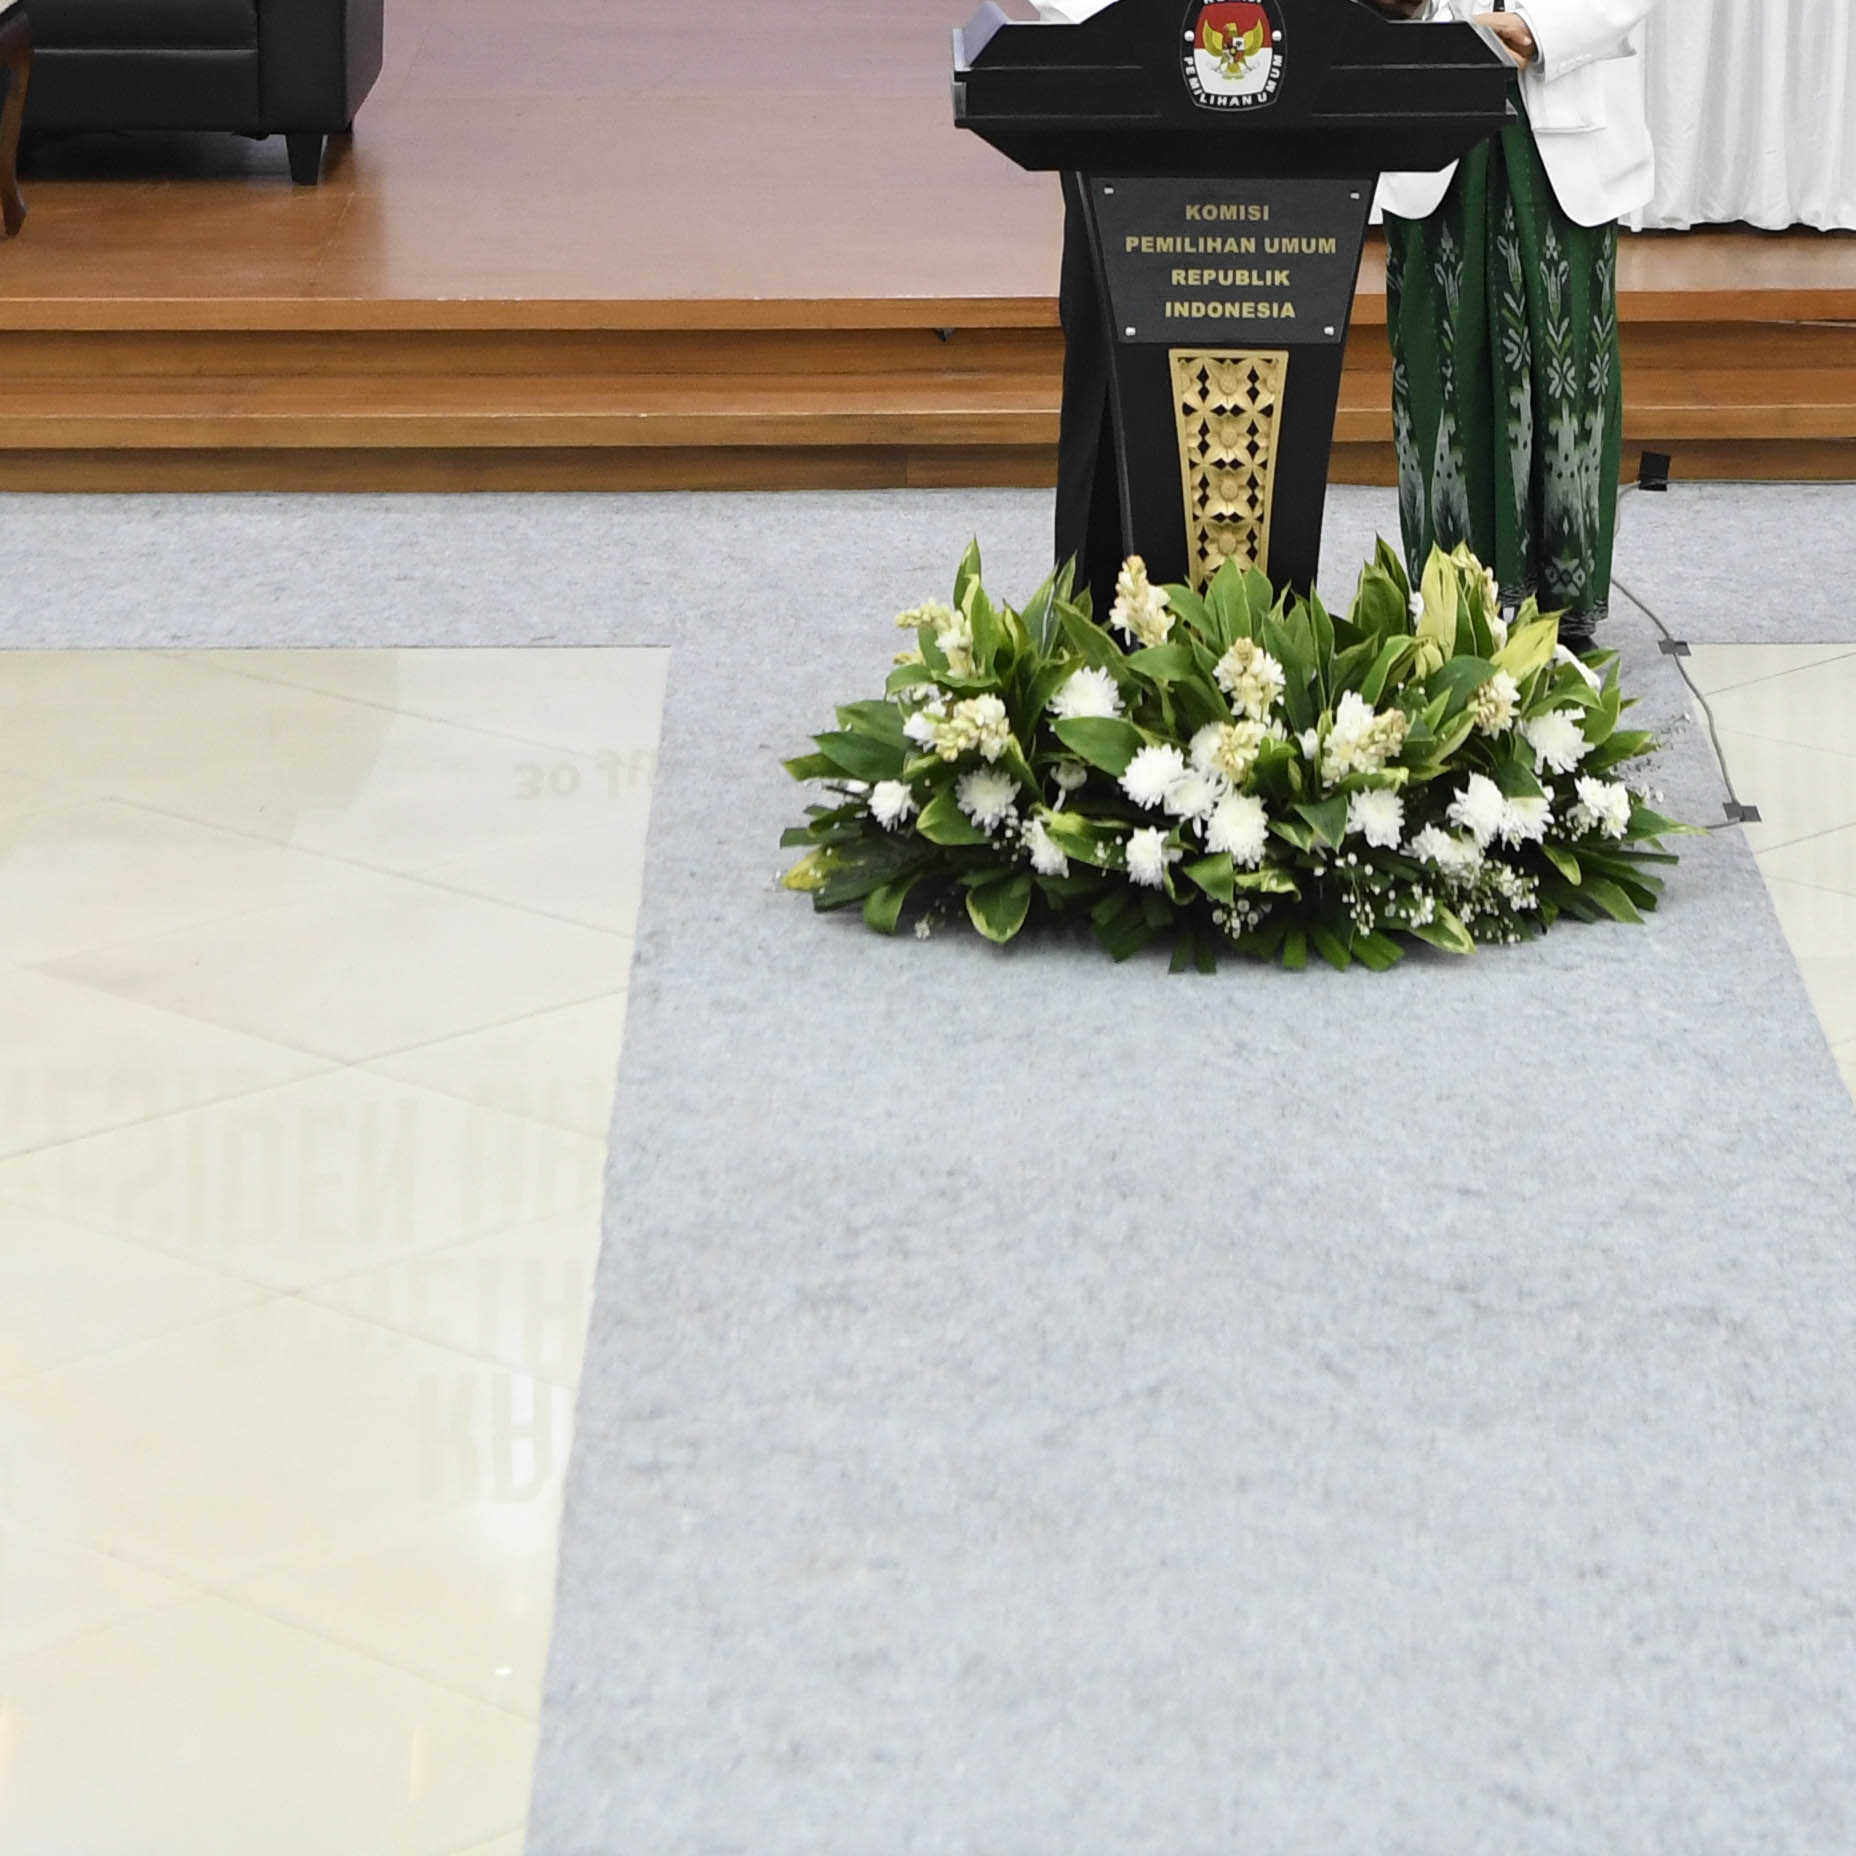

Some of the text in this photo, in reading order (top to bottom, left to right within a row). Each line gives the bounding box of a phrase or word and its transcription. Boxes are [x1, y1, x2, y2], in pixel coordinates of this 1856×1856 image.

[1184, 54, 1283, 106] PEMILIHAN UMUM
[1185, 204, 1269, 221] KOMISI
[1125, 236, 1337, 254] PEMILIHAN UMUM
[1171, 268, 1291, 286] REPUBLIK
[1165, 301, 1296, 319] INDONESIA
